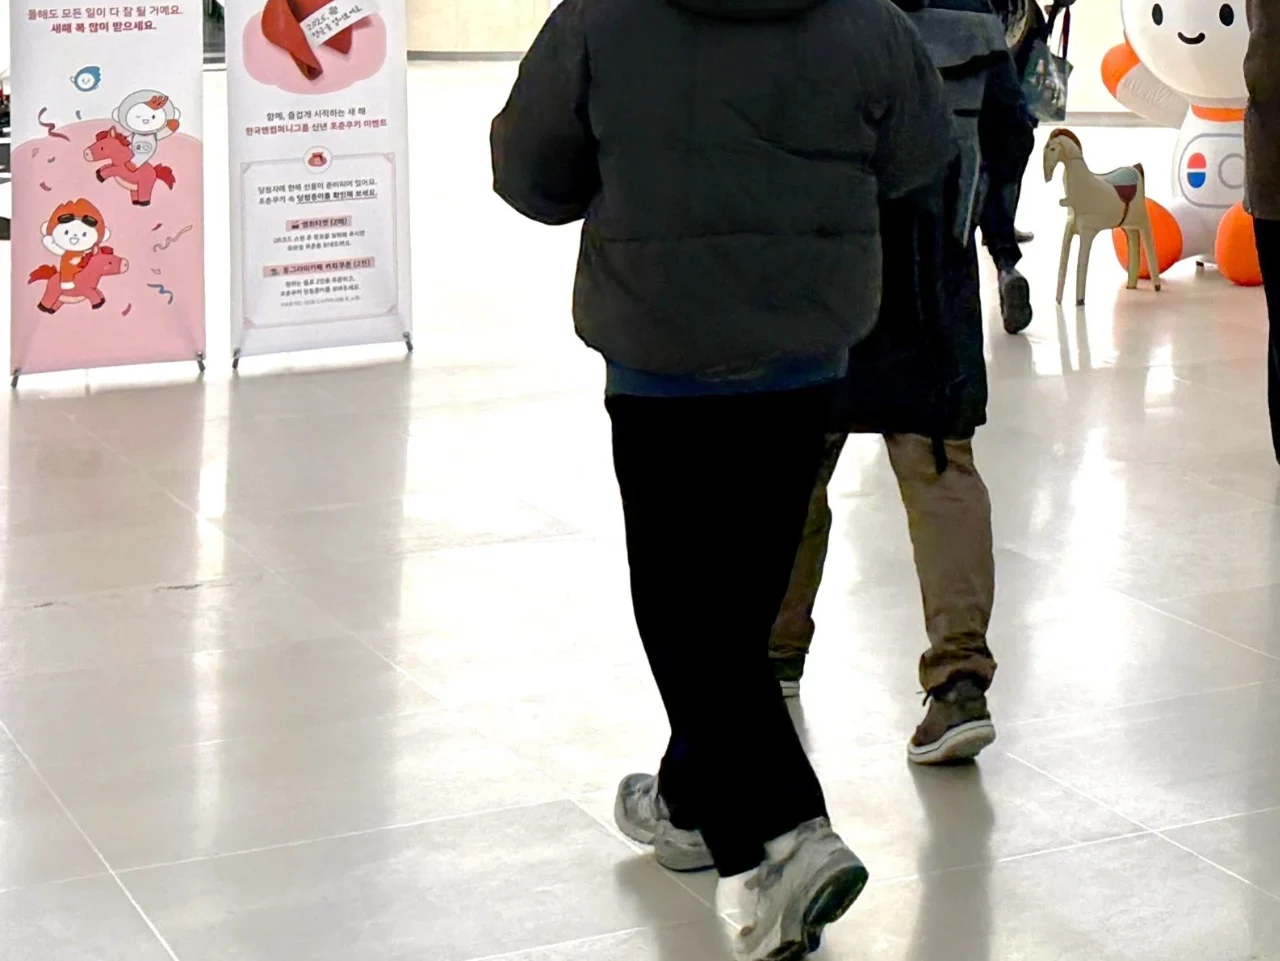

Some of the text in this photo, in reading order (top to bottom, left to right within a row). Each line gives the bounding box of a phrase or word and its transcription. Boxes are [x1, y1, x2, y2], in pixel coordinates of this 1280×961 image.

[27, 4, 183, 21] 올해도 모든 일이 다 잘 될 거예요.
[51, 20, 157, 34] 새해 복 많이 받으세요.
[314, 108, 345, 119] 시작하는
[311, 122, 328, 132] 신년
[330, 119, 361, 131] 포춘쿠키
[364, 118, 388, 128] 이벤트
